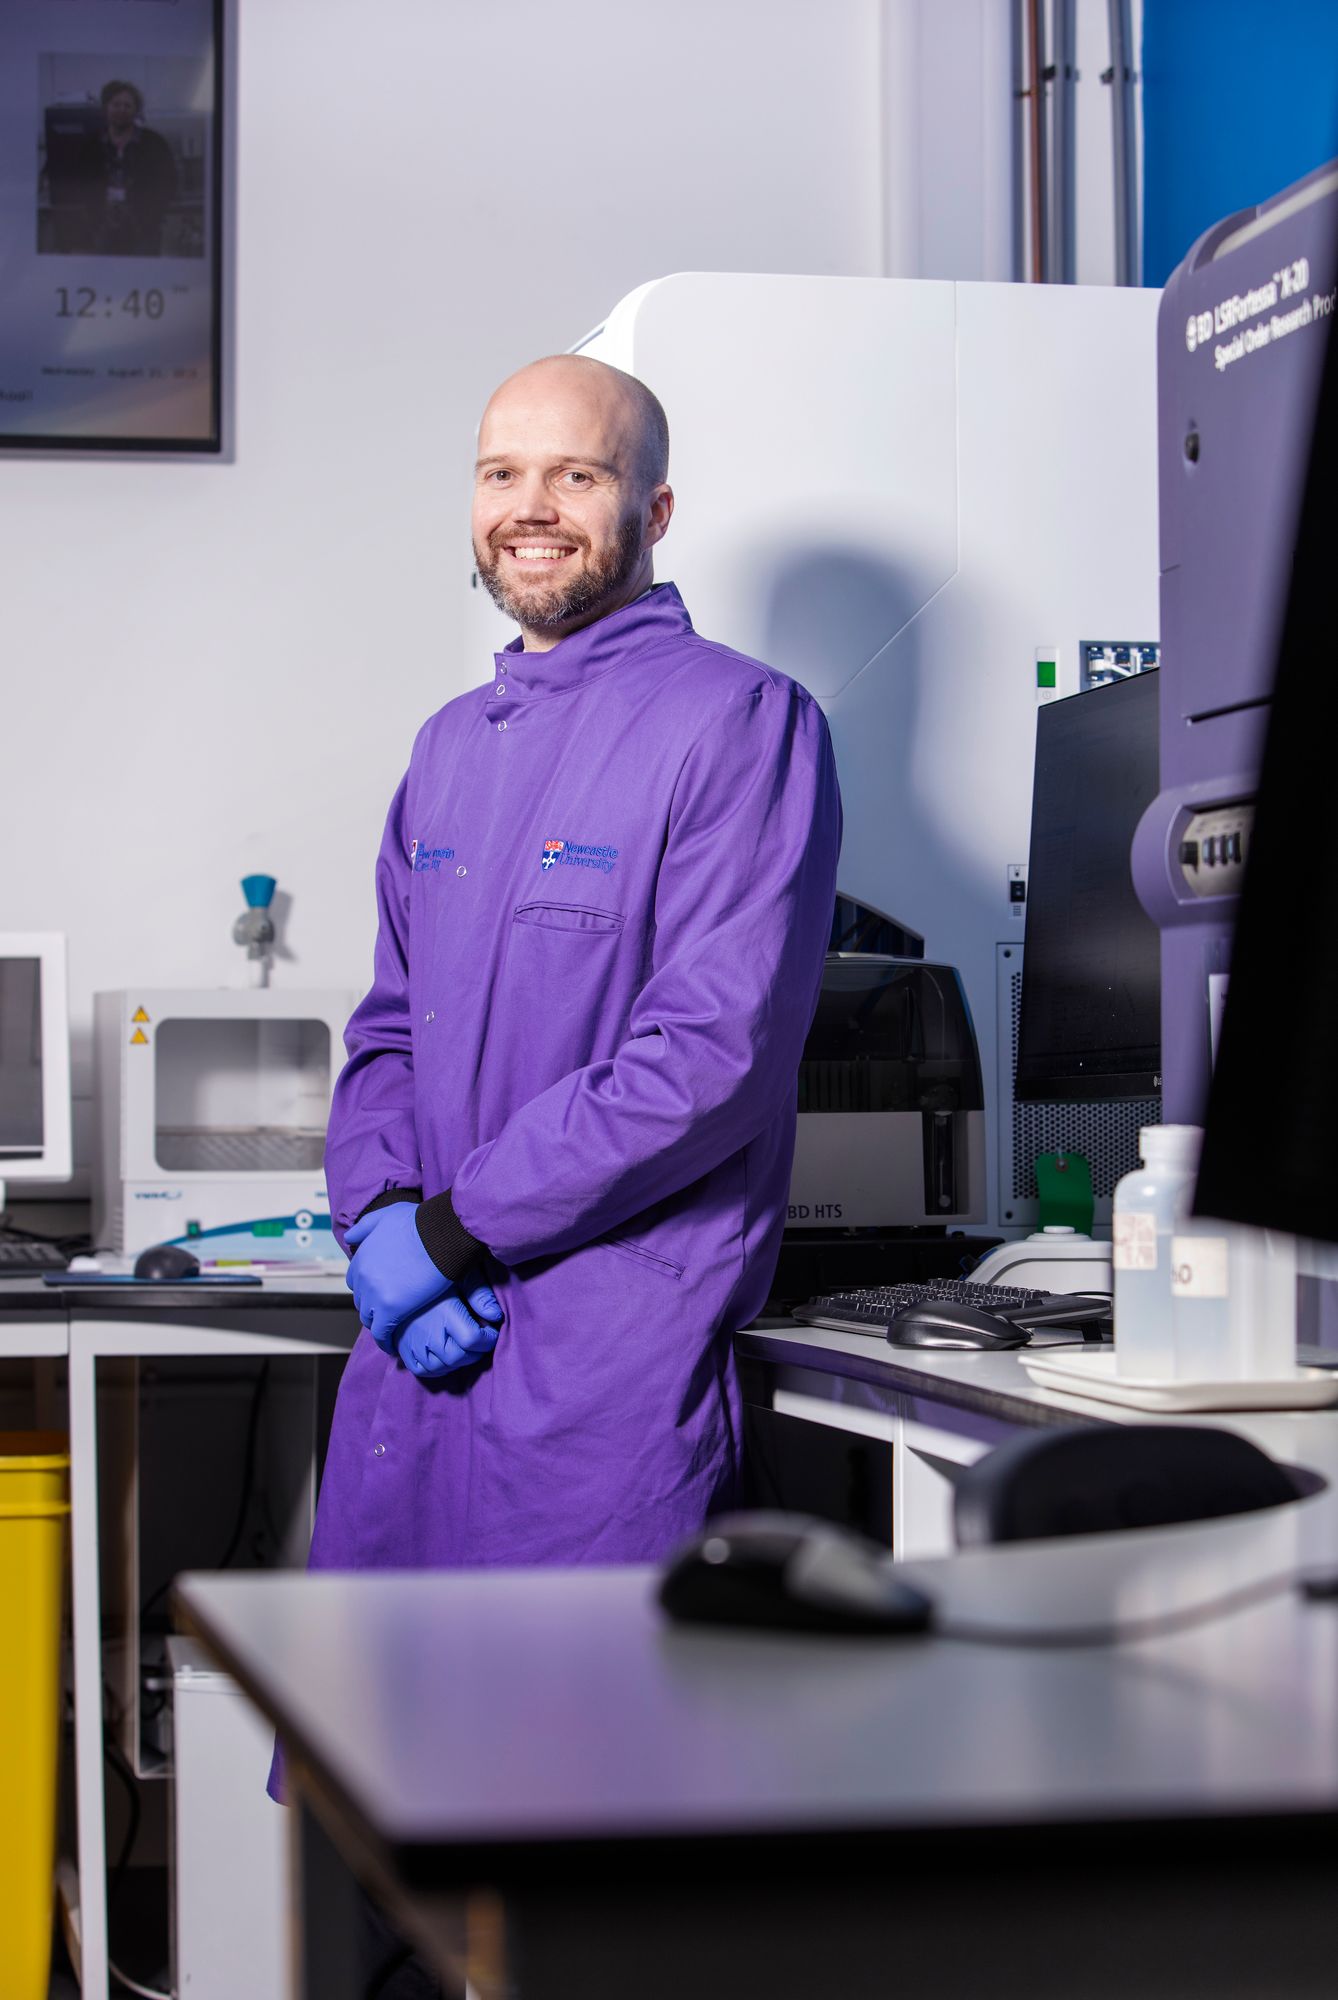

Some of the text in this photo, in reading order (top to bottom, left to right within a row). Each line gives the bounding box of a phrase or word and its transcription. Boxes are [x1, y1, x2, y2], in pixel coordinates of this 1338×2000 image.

[55, 287, 165, 320] 12:40
[564, 840, 618, 860] Newcastle
[559, 853, 615, 874] University
[787, 1204, 842, 1219] BD HTS
